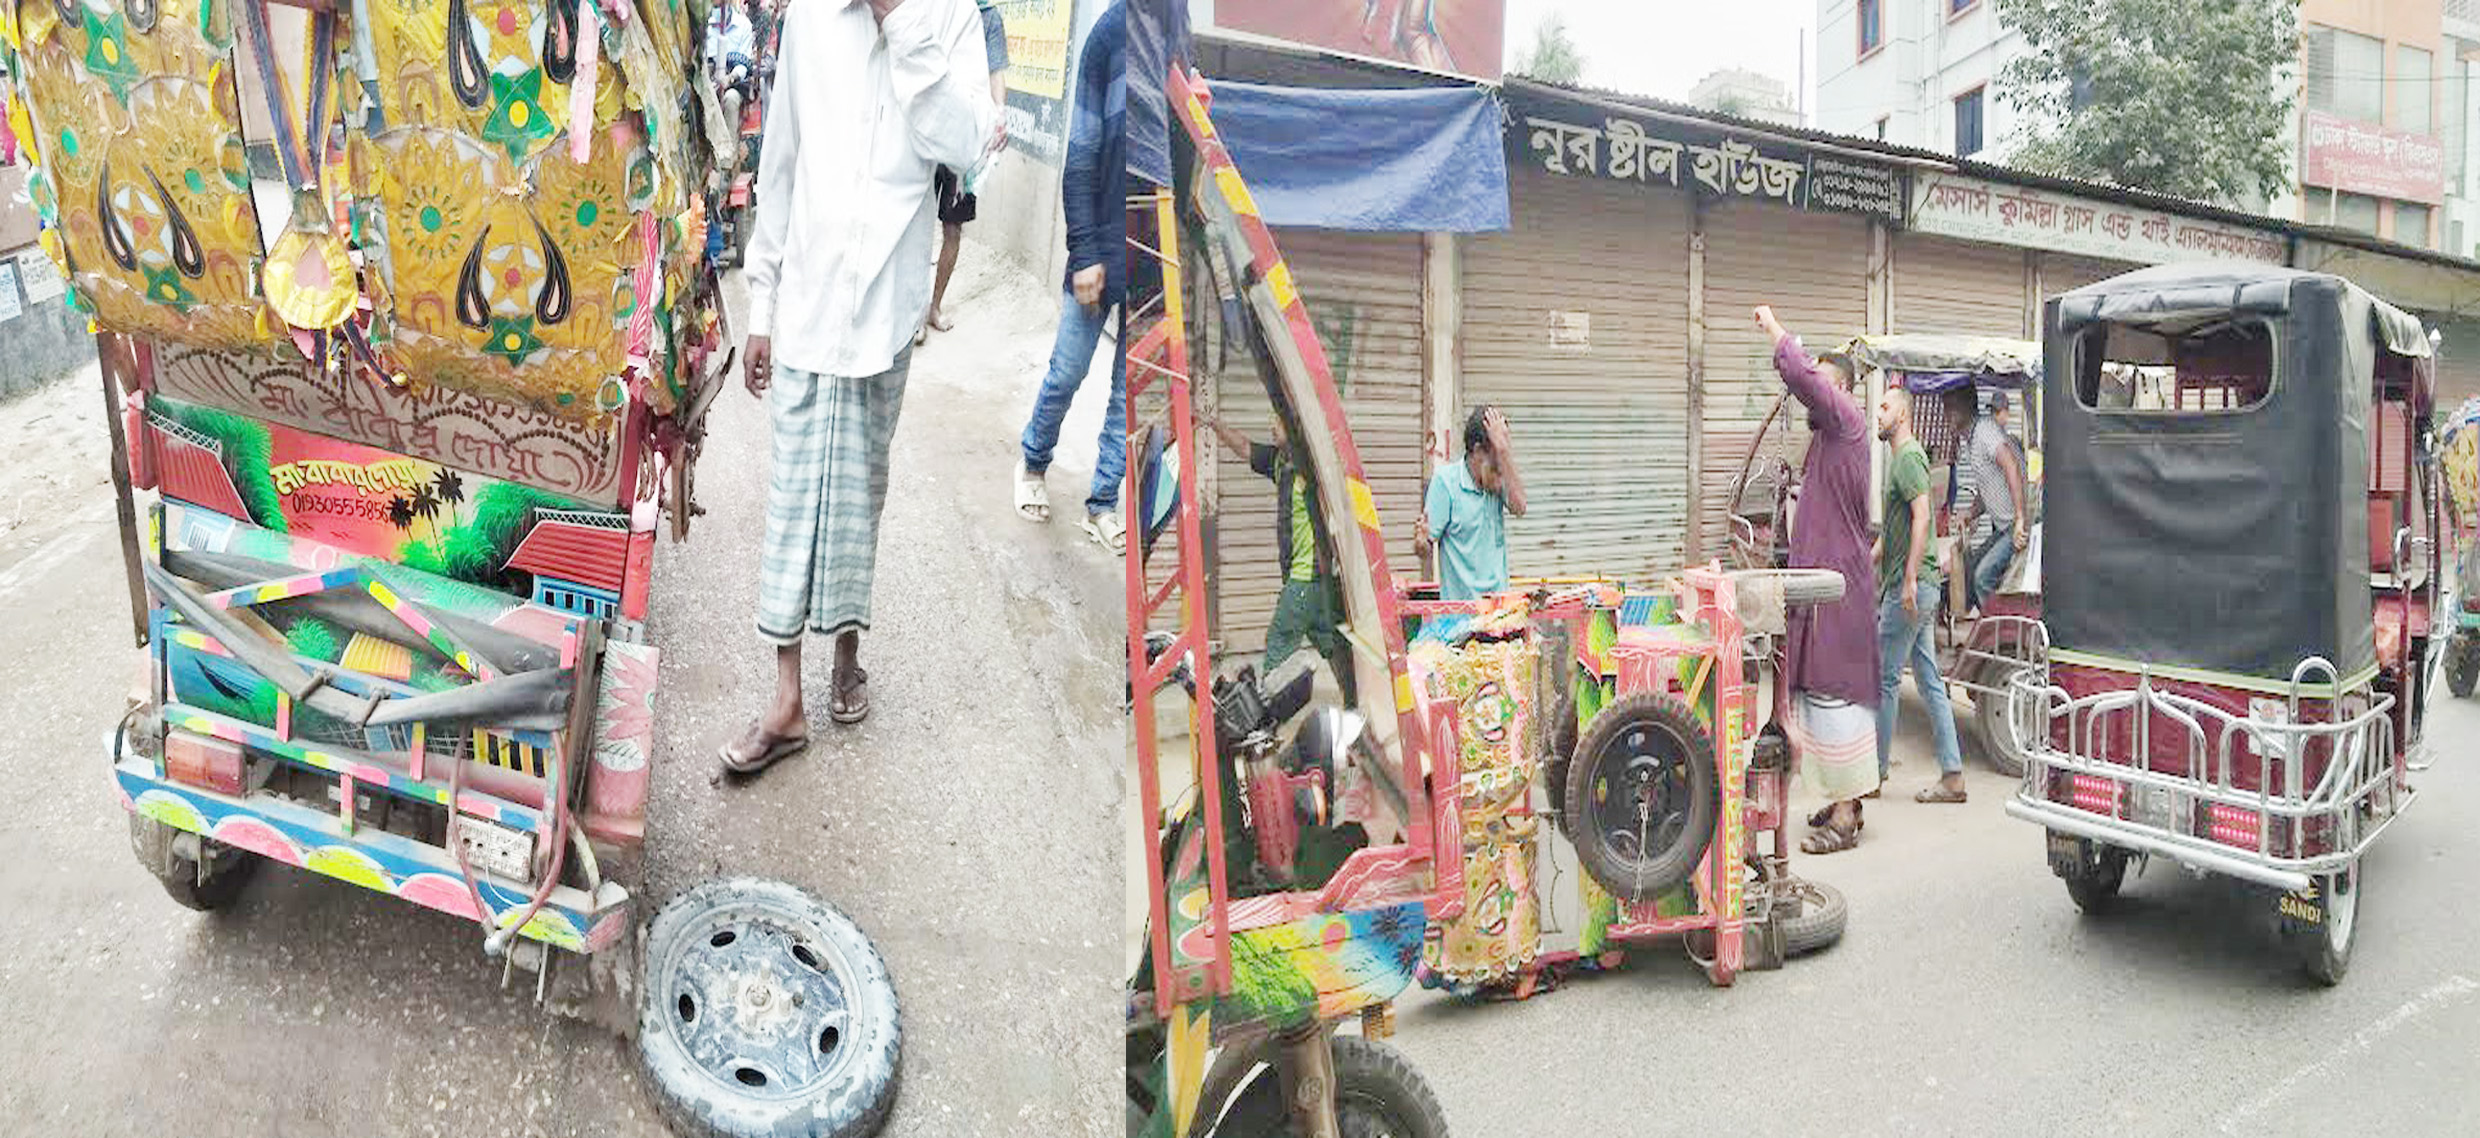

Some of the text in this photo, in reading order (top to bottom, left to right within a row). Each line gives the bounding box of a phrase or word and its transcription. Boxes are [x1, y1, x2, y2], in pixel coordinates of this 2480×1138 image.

[1526, 116, 1604, 177] নূর
[1687, 138, 1806, 207] হাউজ
[1996, 188, 2060, 229] কুমিল্লা
[2063, 204, 2098, 234] গ্লাস
[2280, 896, 2321, 924] SANDI
